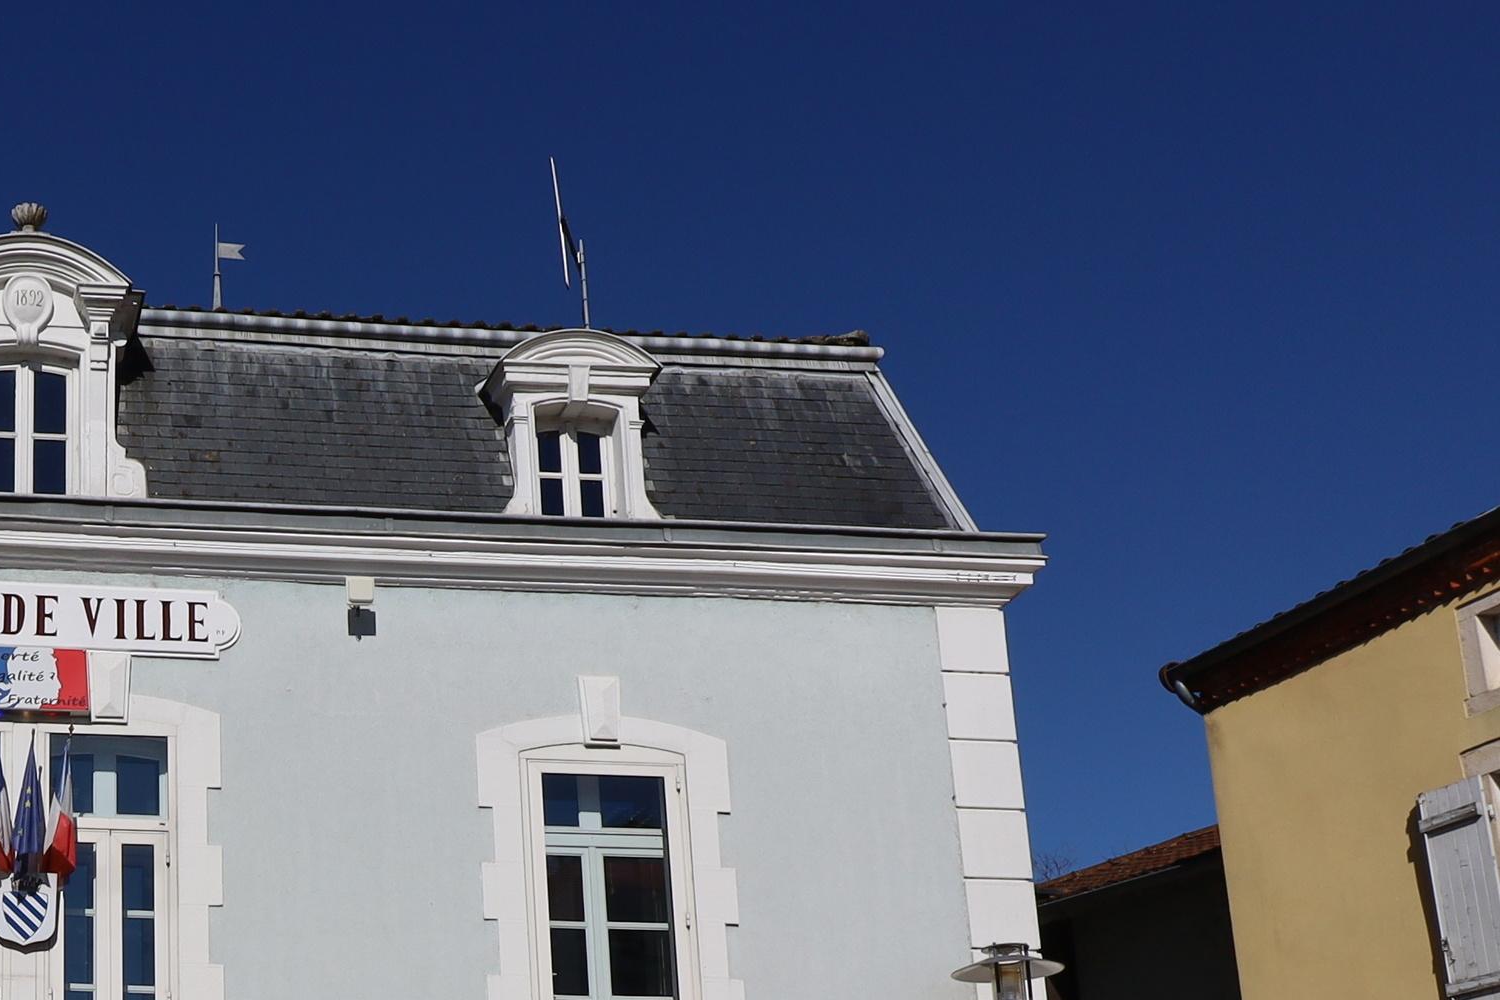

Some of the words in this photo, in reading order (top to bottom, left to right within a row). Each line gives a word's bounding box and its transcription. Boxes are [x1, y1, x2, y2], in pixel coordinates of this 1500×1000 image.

[14, 289, 44, 307] 1892
[0, 593, 59, 637] DE
[80, 597, 209, 643] VILLE
[7, 694, 86, 706] Fraternité
